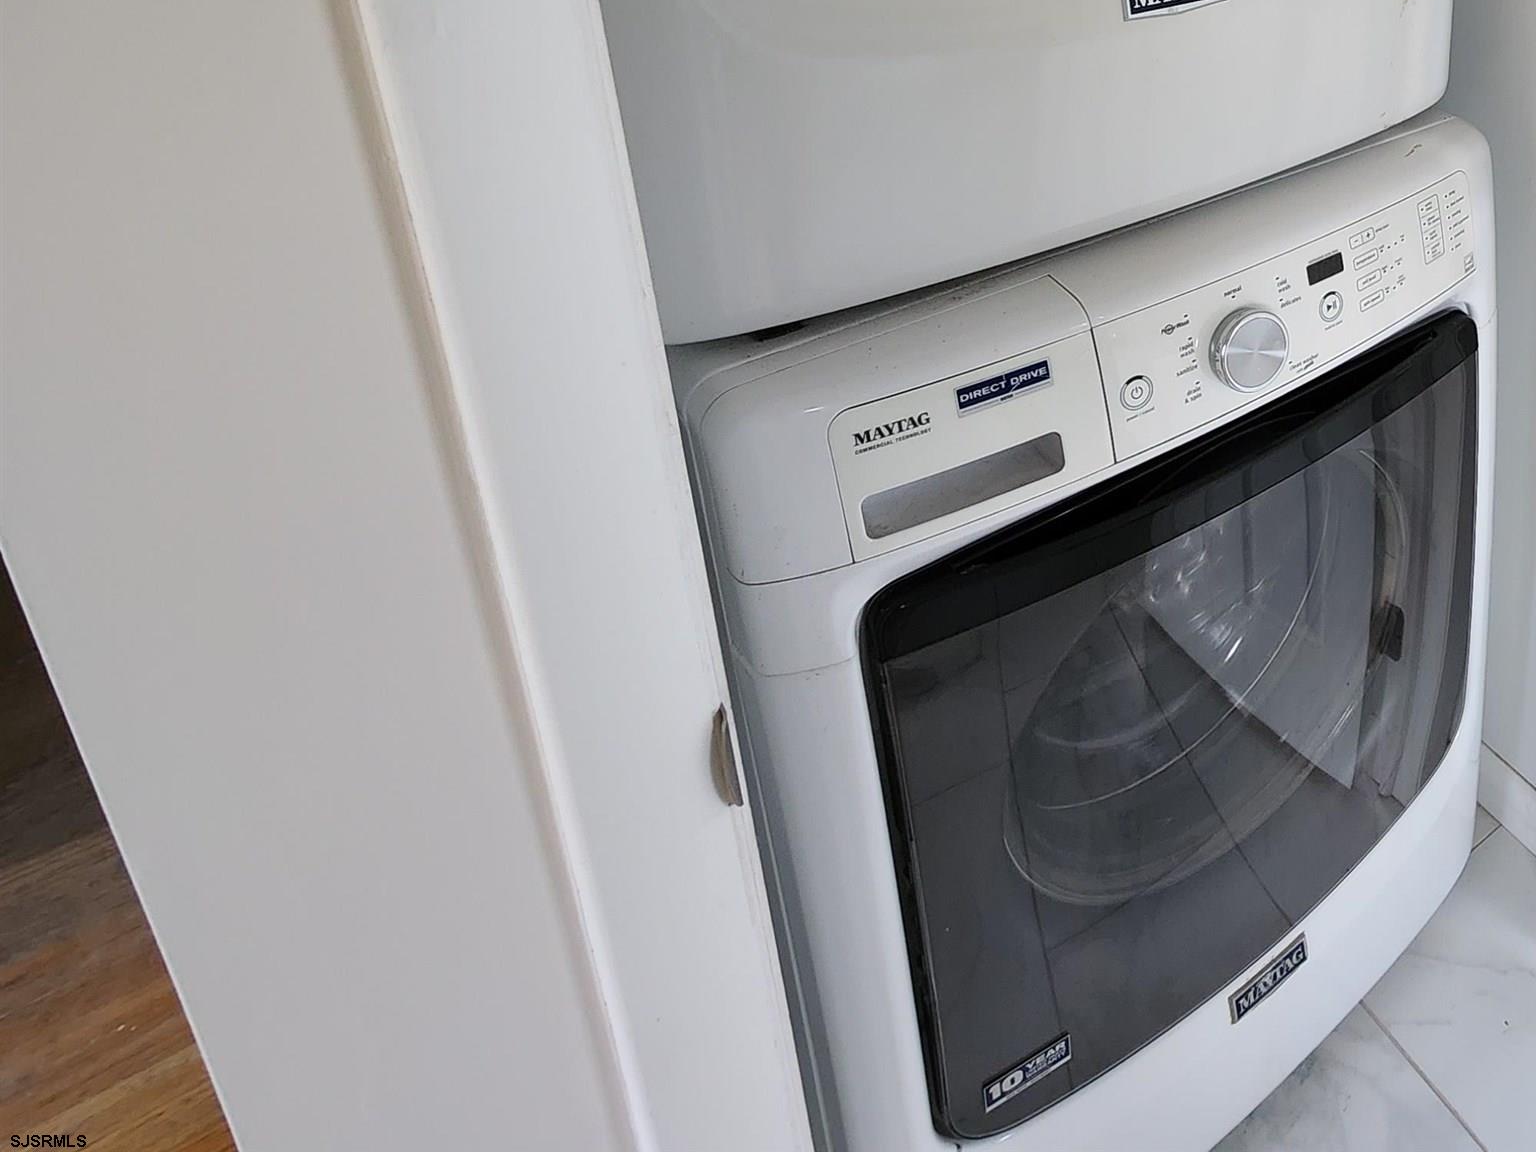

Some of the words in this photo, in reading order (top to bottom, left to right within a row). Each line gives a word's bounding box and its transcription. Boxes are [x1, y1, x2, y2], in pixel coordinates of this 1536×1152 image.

[959, 380, 1007, 403] DIRECT
[1010, 366, 1049, 386] DRIVE
[852, 411, 931, 447] MAYTAG
[854, 439, 893, 456] COMMERCIAL
[895, 427, 932, 443] TECHNOLOGY
[1237, 947, 1305, 1013] MAYTAG
[988, 1069, 1025, 1102] 10
